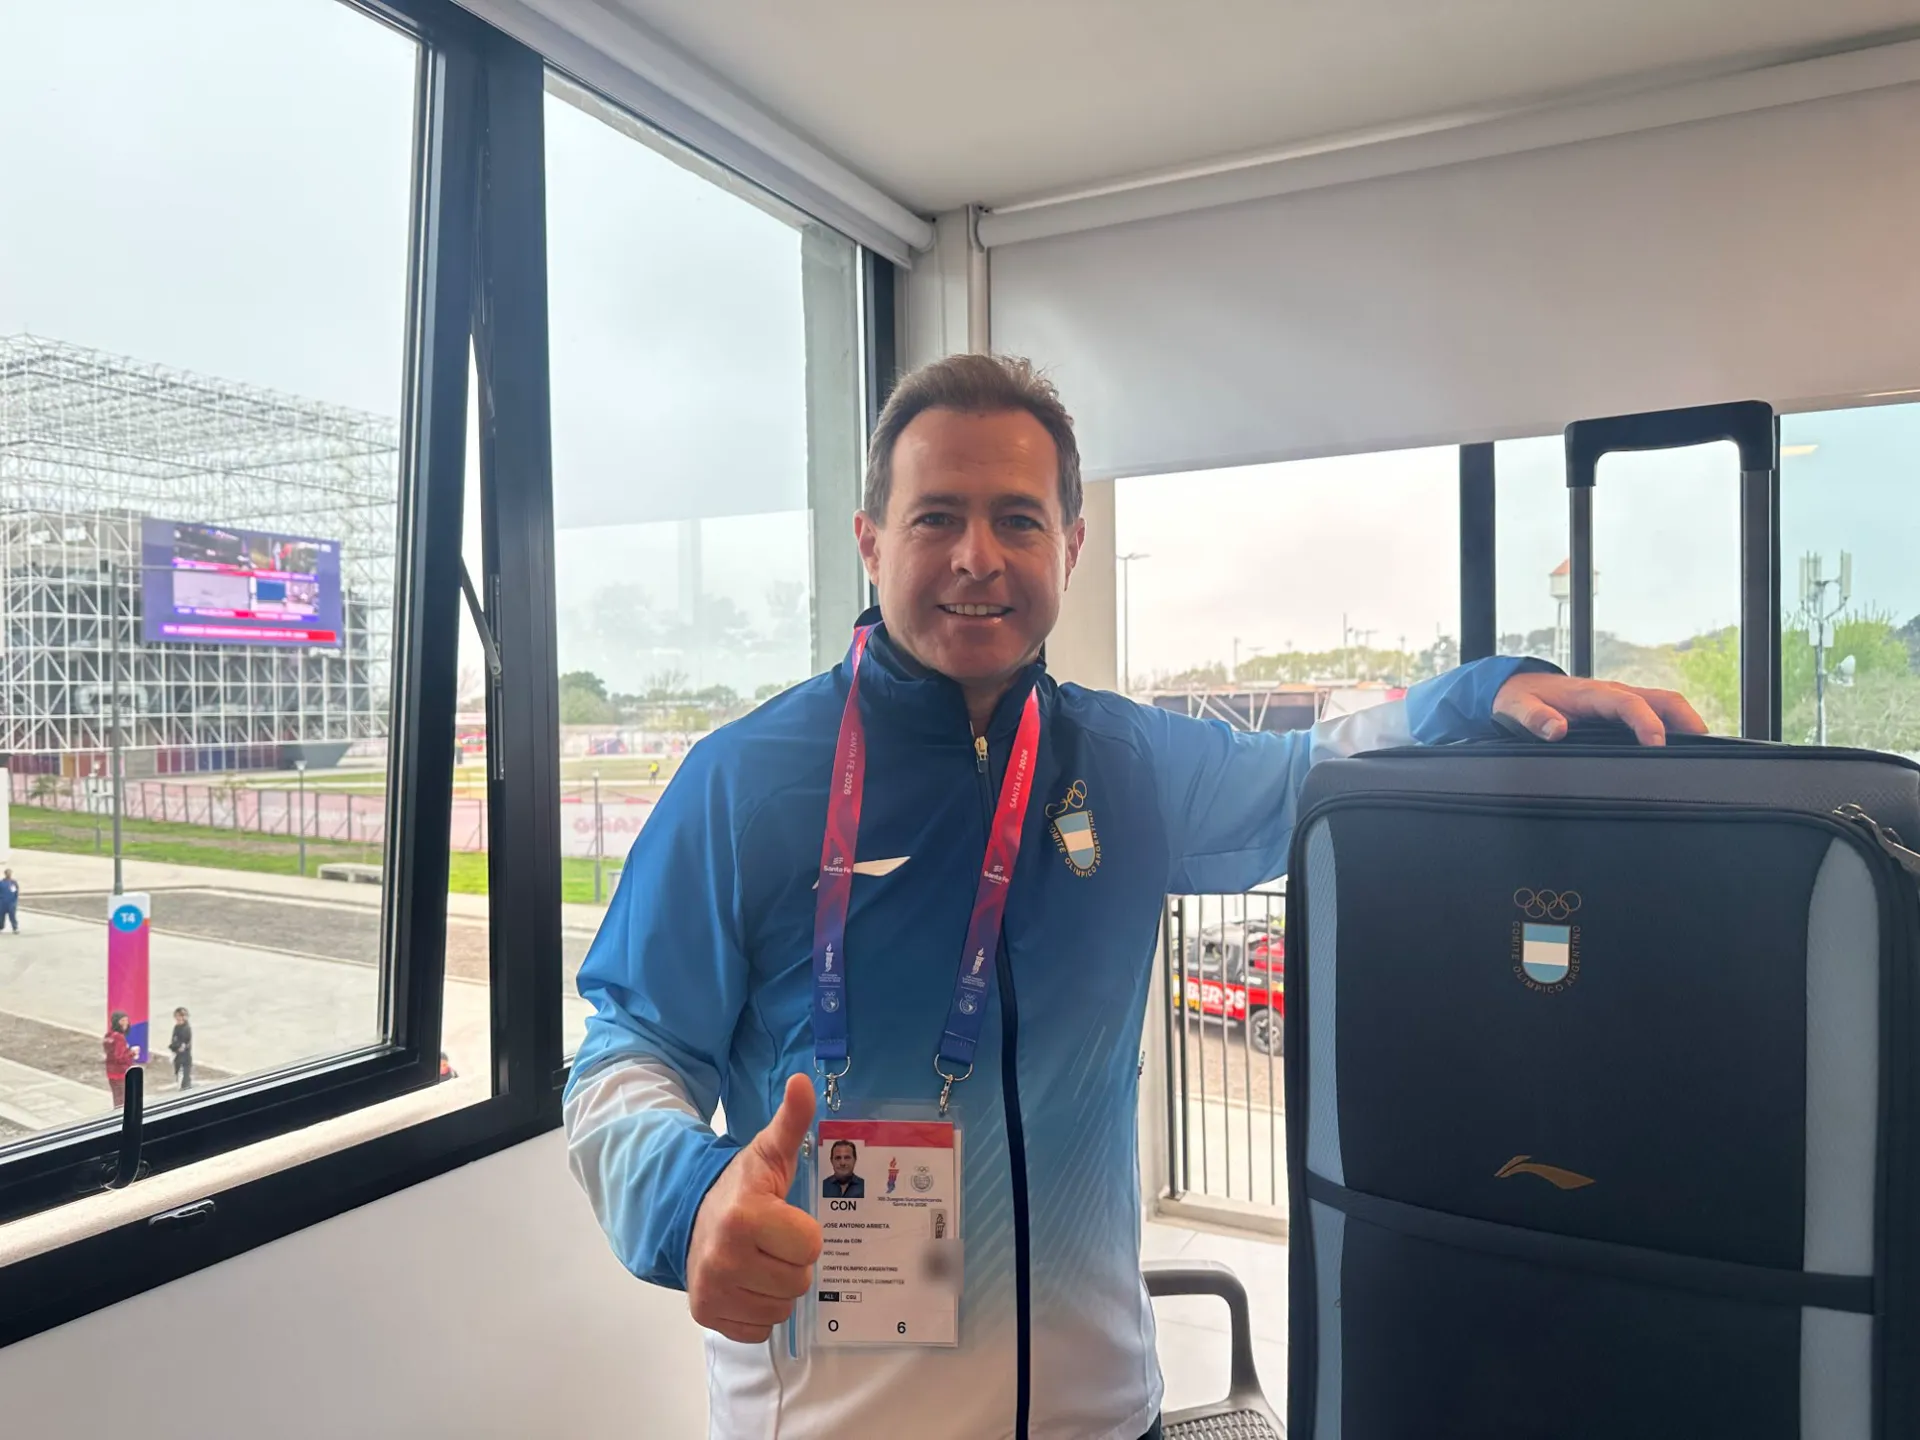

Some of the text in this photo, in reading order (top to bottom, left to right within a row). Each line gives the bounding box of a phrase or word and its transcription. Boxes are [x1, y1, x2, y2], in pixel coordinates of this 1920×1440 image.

[843, 732, 858, 795] SANTA FE 2026
[1009, 779, 1022, 809] SANTA
[1016, 771, 1025, 781] FE
[823, 865, 843, 873] Santa
[1064, 857, 1098, 878] OLIMPICO
[1511, 920, 1581, 994] COMITE OLIMPICO ARGENTINO
[830, 1200, 857, 1211] CON
[897, 1321, 906, 1334] 6
